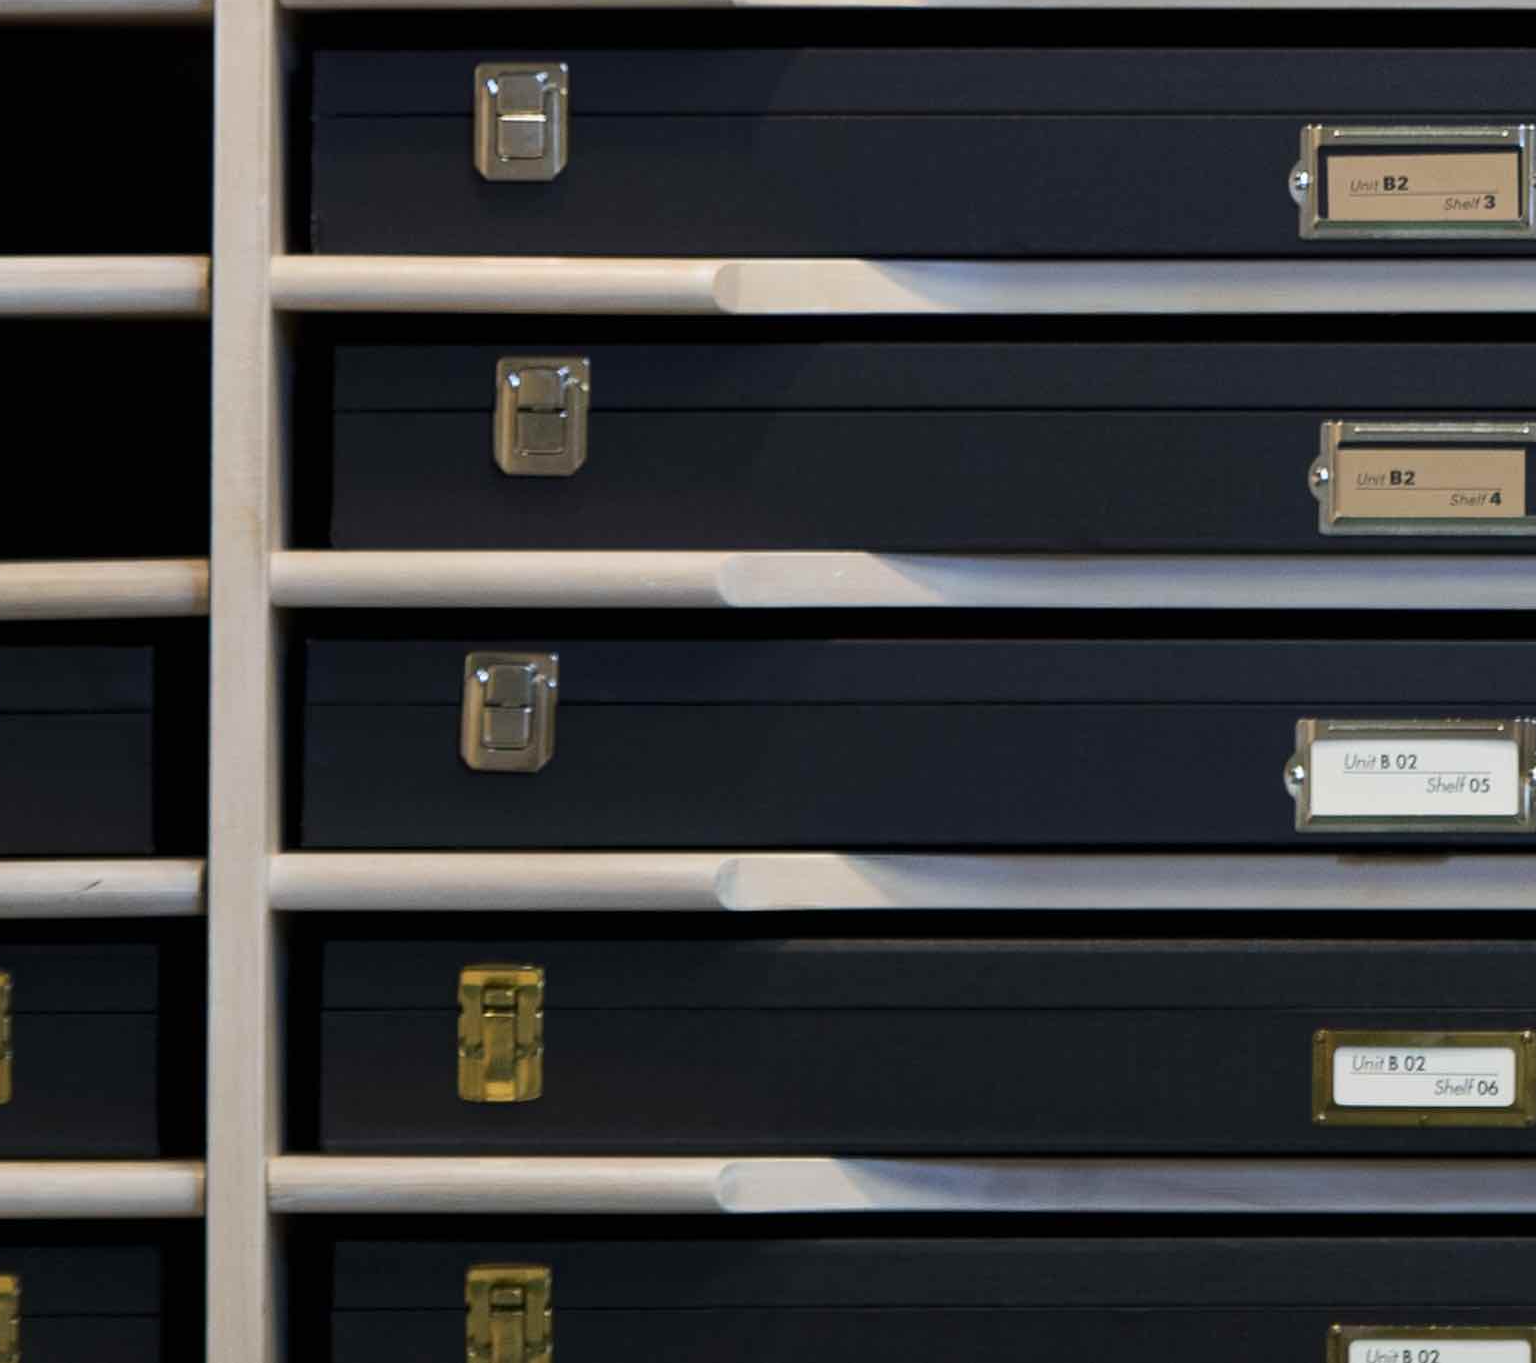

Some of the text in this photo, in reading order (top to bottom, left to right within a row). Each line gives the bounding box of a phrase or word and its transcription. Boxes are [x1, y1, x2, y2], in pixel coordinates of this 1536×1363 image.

[1350, 176, 1408, 192] Unit B2
[1444, 195, 1496, 211] Shelf 3
[1356, 470, 1415, 486] Unit B2
[1450, 491, 1502, 506] Shelf 4
[1344, 754, 1418, 770] Unit B 02
[1426, 777, 1491, 794] Shelf 05
[1352, 1055, 1426, 1072] Unit B 02
[1434, 1078, 1499, 1096] Shelf 06
[1366, 1349, 1440, 1363] Unit B 02
